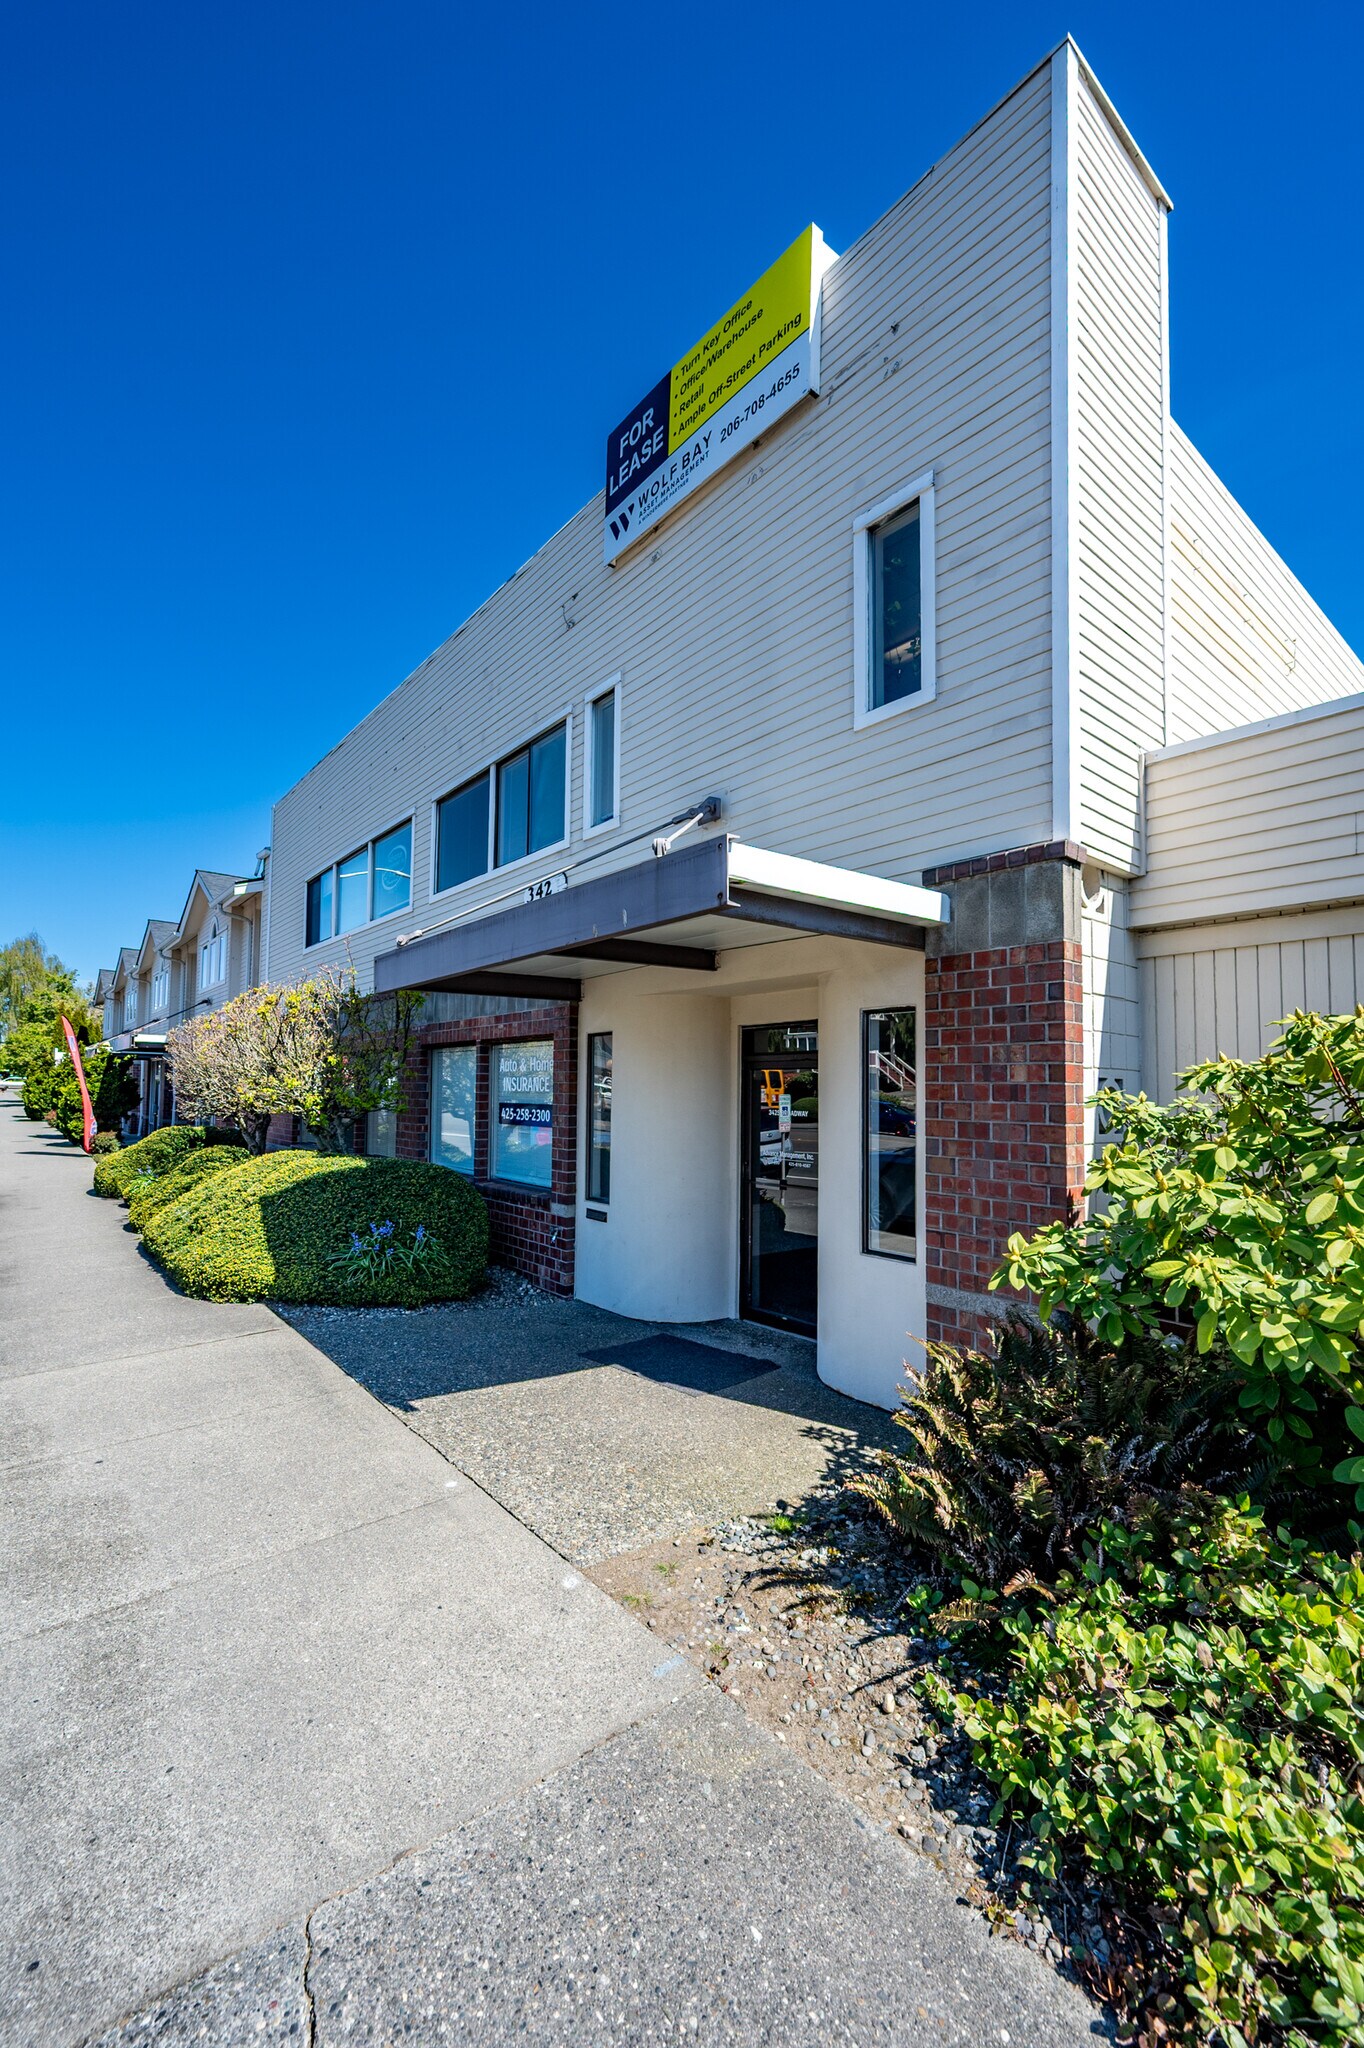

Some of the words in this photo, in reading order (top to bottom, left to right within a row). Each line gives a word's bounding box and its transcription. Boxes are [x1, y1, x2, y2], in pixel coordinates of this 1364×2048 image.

[680, 353, 700, 377] Turn
[703, 332, 721, 355] Key
[723, 300, 753, 334] Office
[680, 308, 764, 396] Office/Warehouse
[678, 402, 706, 436] Ample
[708, 353, 756, 405] Off-Street
[758, 312, 802, 358] Parking
[679, 383, 705, 416] Retail
[720, 362, 801, 443] 206-708-4655
[609, 425, 664, 497] LEASE
[619, 407, 655, 458] FOR
[638, 463, 678, 508] WOLF
[681, 430, 713, 470] BAY
[638, 495, 659, 518] ASSET
[660, 450, 710, 499] MANAGEMENT
[669, 478, 690, 498] PARTNER
[499, 1057, 518, 1072] Auto
[520, 1059, 527, 1072] &
[530, 1057, 554, 1072] Home
[502, 1076, 550, 1093] INSURANCE
[501, 1107, 551, 1123] 425-258-2300
